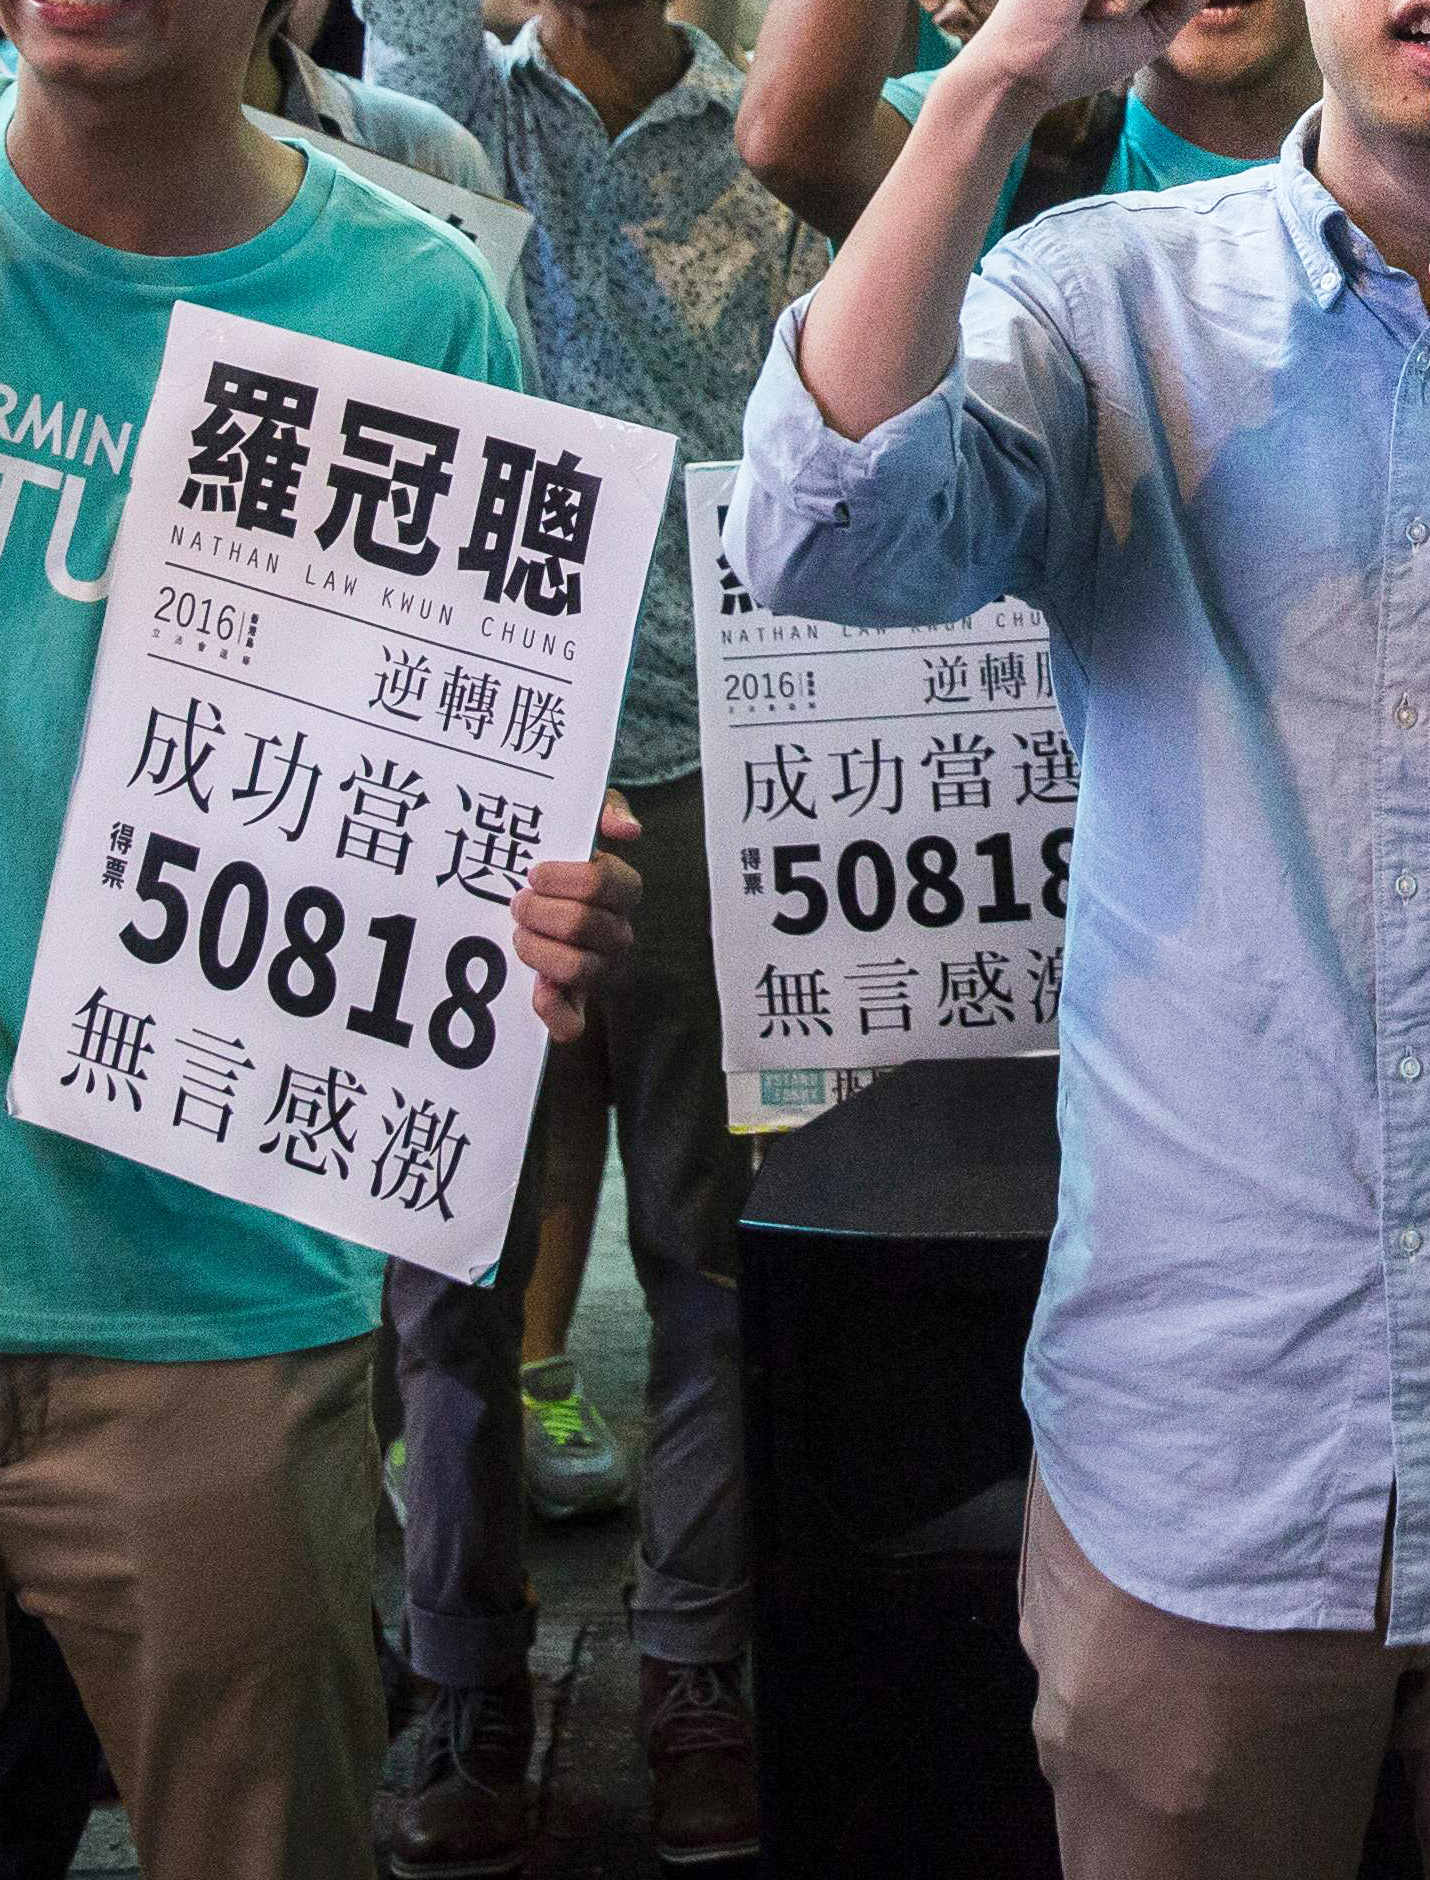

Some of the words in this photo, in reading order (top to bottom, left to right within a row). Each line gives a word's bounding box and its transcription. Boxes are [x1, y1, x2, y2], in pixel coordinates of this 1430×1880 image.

[179, 361, 602, 618] 羅冠聰
[154, 585, 235, 642] 2016
[170, 524, 280, 574] NATHAN
[305, 565, 358, 597] LAW
[382, 585, 454, 627] KWUN
[481, 615, 577, 660] CHUNG
[720, 624, 818, 646] NATHAN
[368, 644, 566, 761] 逆轉勝
[725, 671, 795, 701] 2016
[126, 696, 542, 907] 成功當選
[742, 729, 1082, 824] 成功當選
[100, 820, 134, 891] 得票
[741, 847, 765, 896] 得票
[770, 824, 1075, 938] 50818
[118, 831, 508, 1070] 50818
[59, 985, 473, 1223] 無言感激
